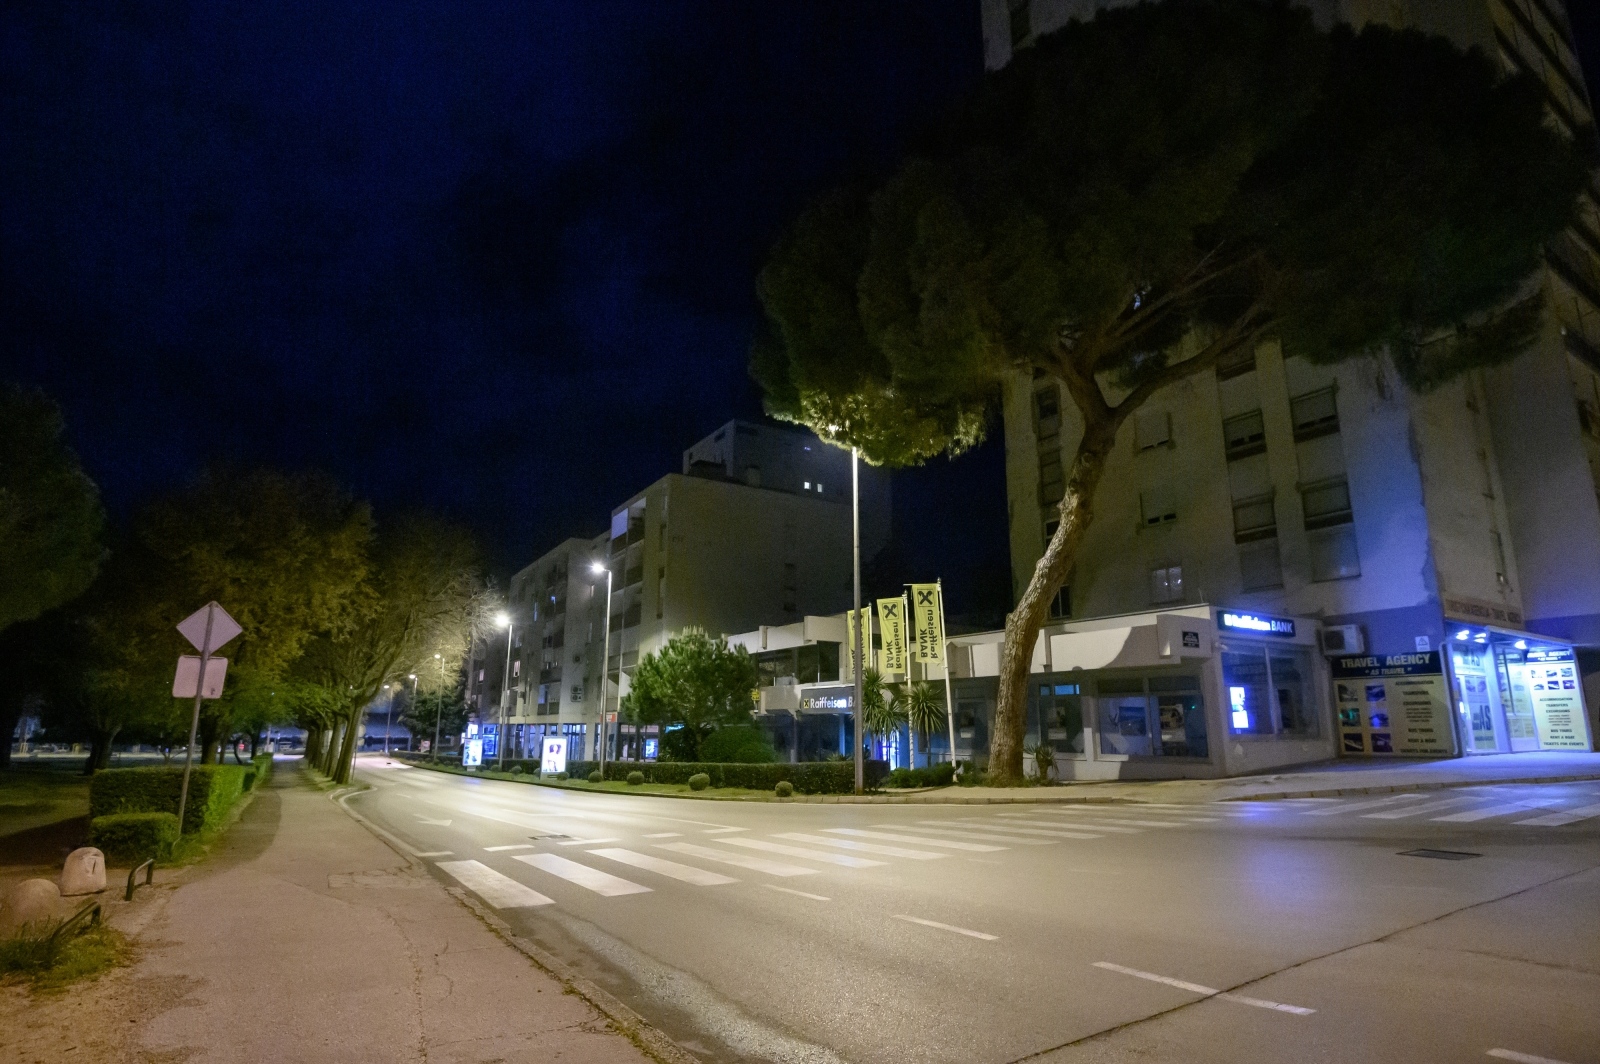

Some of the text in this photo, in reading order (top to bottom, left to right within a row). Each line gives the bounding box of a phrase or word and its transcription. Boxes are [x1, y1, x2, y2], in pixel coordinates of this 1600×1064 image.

[1271, 620, 1293, 633] BANK
[1341, 653, 1430, 668] TRAVEL AGENCY
[810, 696, 847, 709] Raiffeisen
